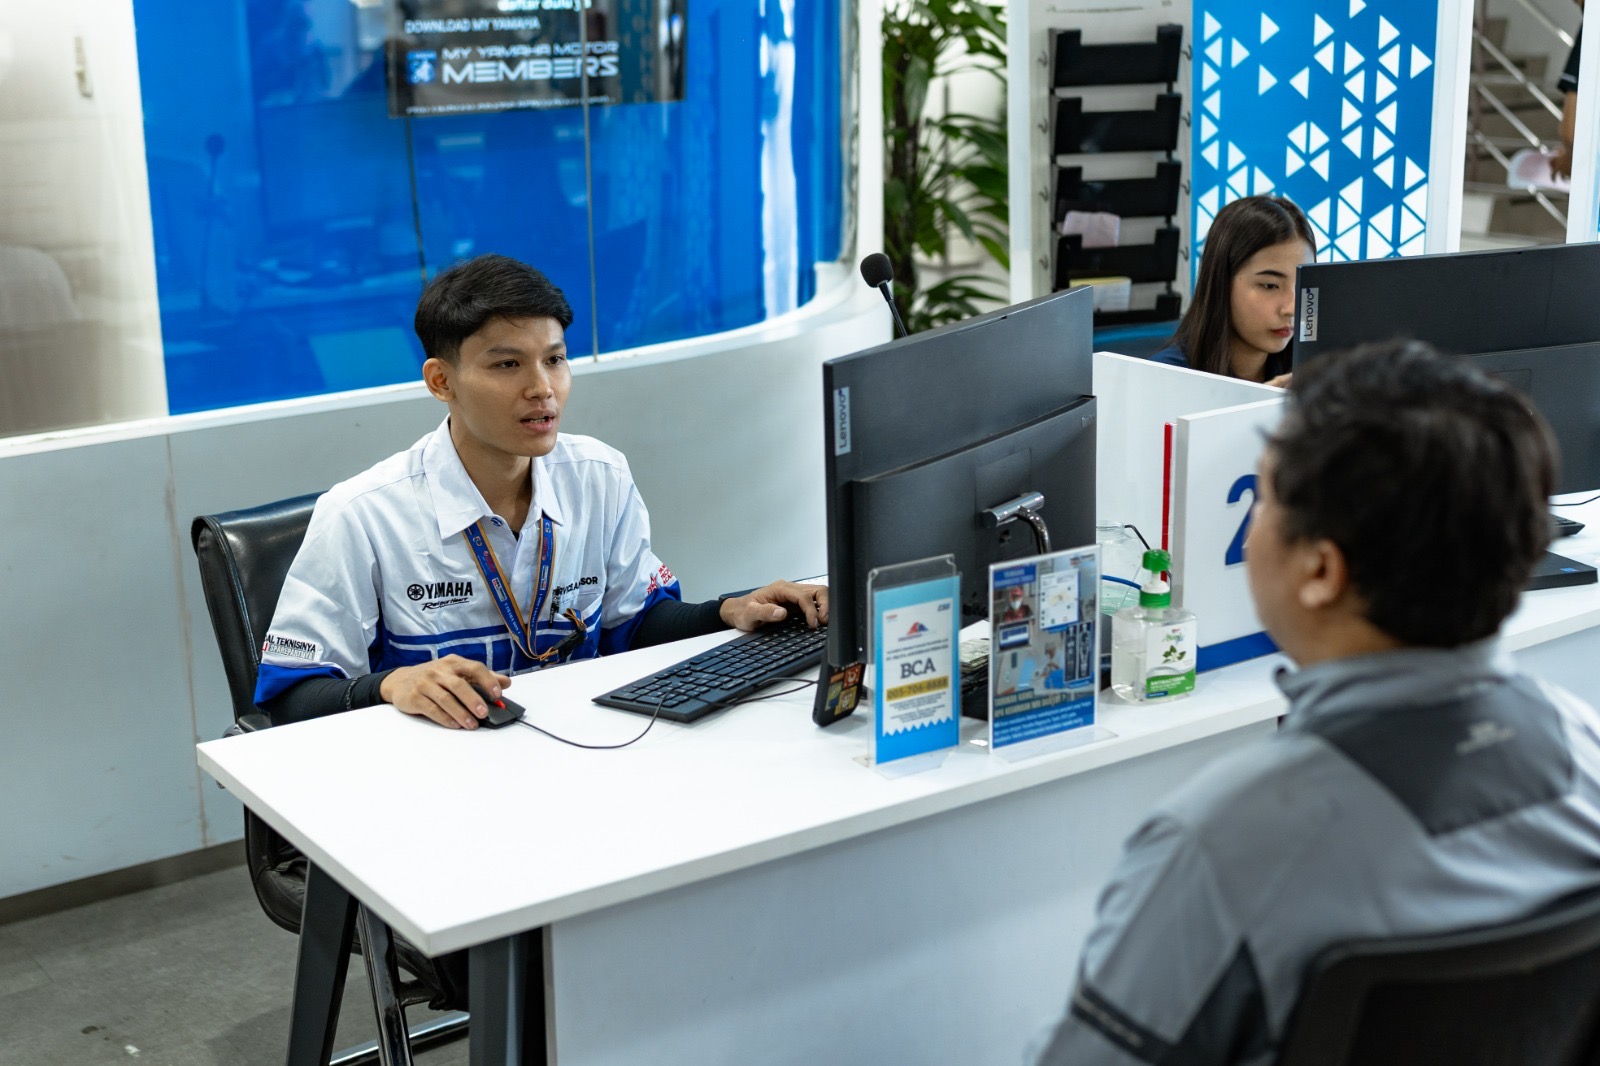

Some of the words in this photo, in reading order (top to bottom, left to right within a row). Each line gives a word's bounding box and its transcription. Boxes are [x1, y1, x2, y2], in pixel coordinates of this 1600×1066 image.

[405, 18, 470, 33] DOWNLOAD
[472, 17, 491, 31] MY
[493, 16, 540, 31] YAMAHA
[442, 46, 471, 60] MY
[476, 43, 551, 59] YAMAHA
[553, 40, 619, 55] MOTOR
[442, 56, 619, 83] MEMBERS
[1304, 292, 1314, 337] Lenovo
[838, 394, 847, 449] Lenovo
[1225, 474, 1259, 566] 2
[425, 581, 473, 599] YAMAHA
[277, 637, 316, 653] TEKNISINYA
[900, 657, 936, 679] BCA
